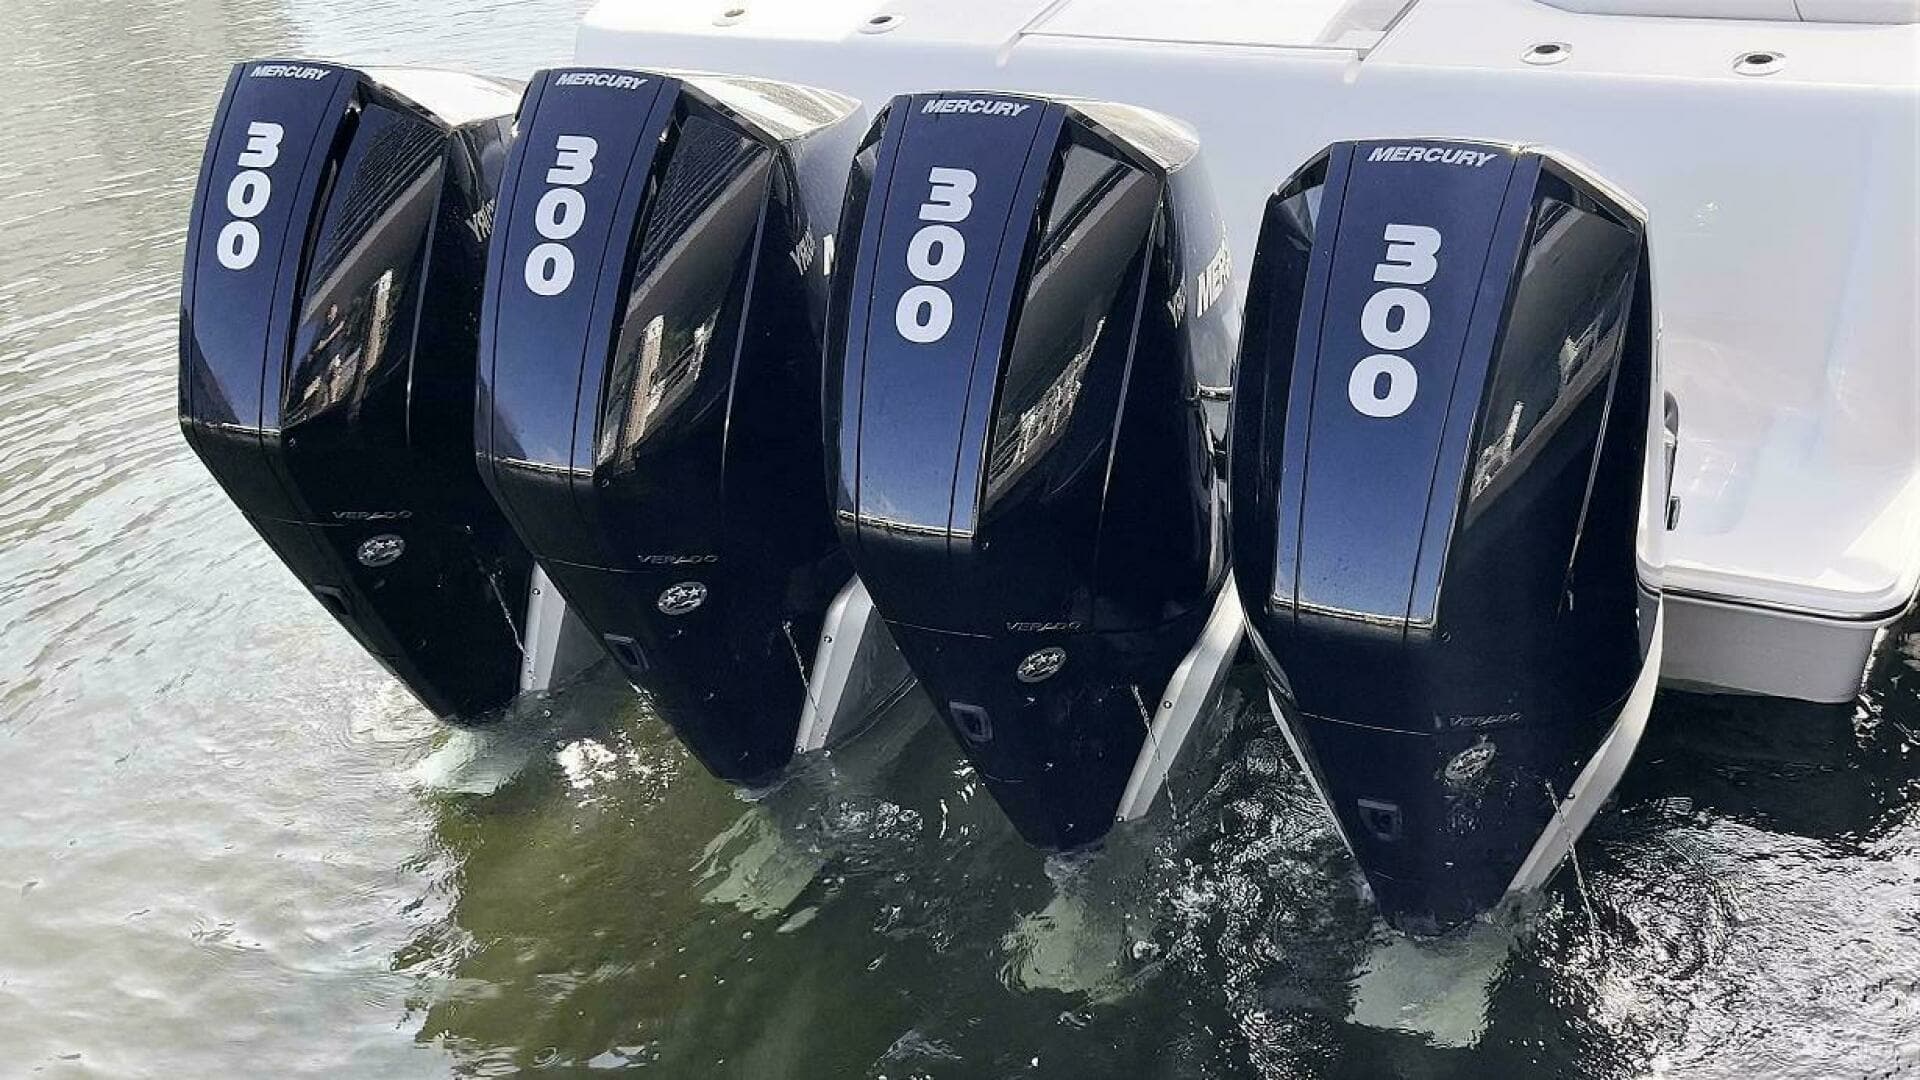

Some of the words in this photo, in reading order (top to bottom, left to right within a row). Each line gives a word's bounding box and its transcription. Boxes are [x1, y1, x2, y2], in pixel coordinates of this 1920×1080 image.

[249, 65, 331, 82] MERCURY
[555, 72, 649, 91] MERCURY
[920, 99, 1031, 118] MERCURY
[1367, 146, 1498, 168] MERCURY
[216, 121, 285, 270] 300
[524, 135, 599, 296] 300
[895, 166, 978, 343] 300
[1348, 223, 1442, 418] 300
[332, 510, 414, 522] VERADO
